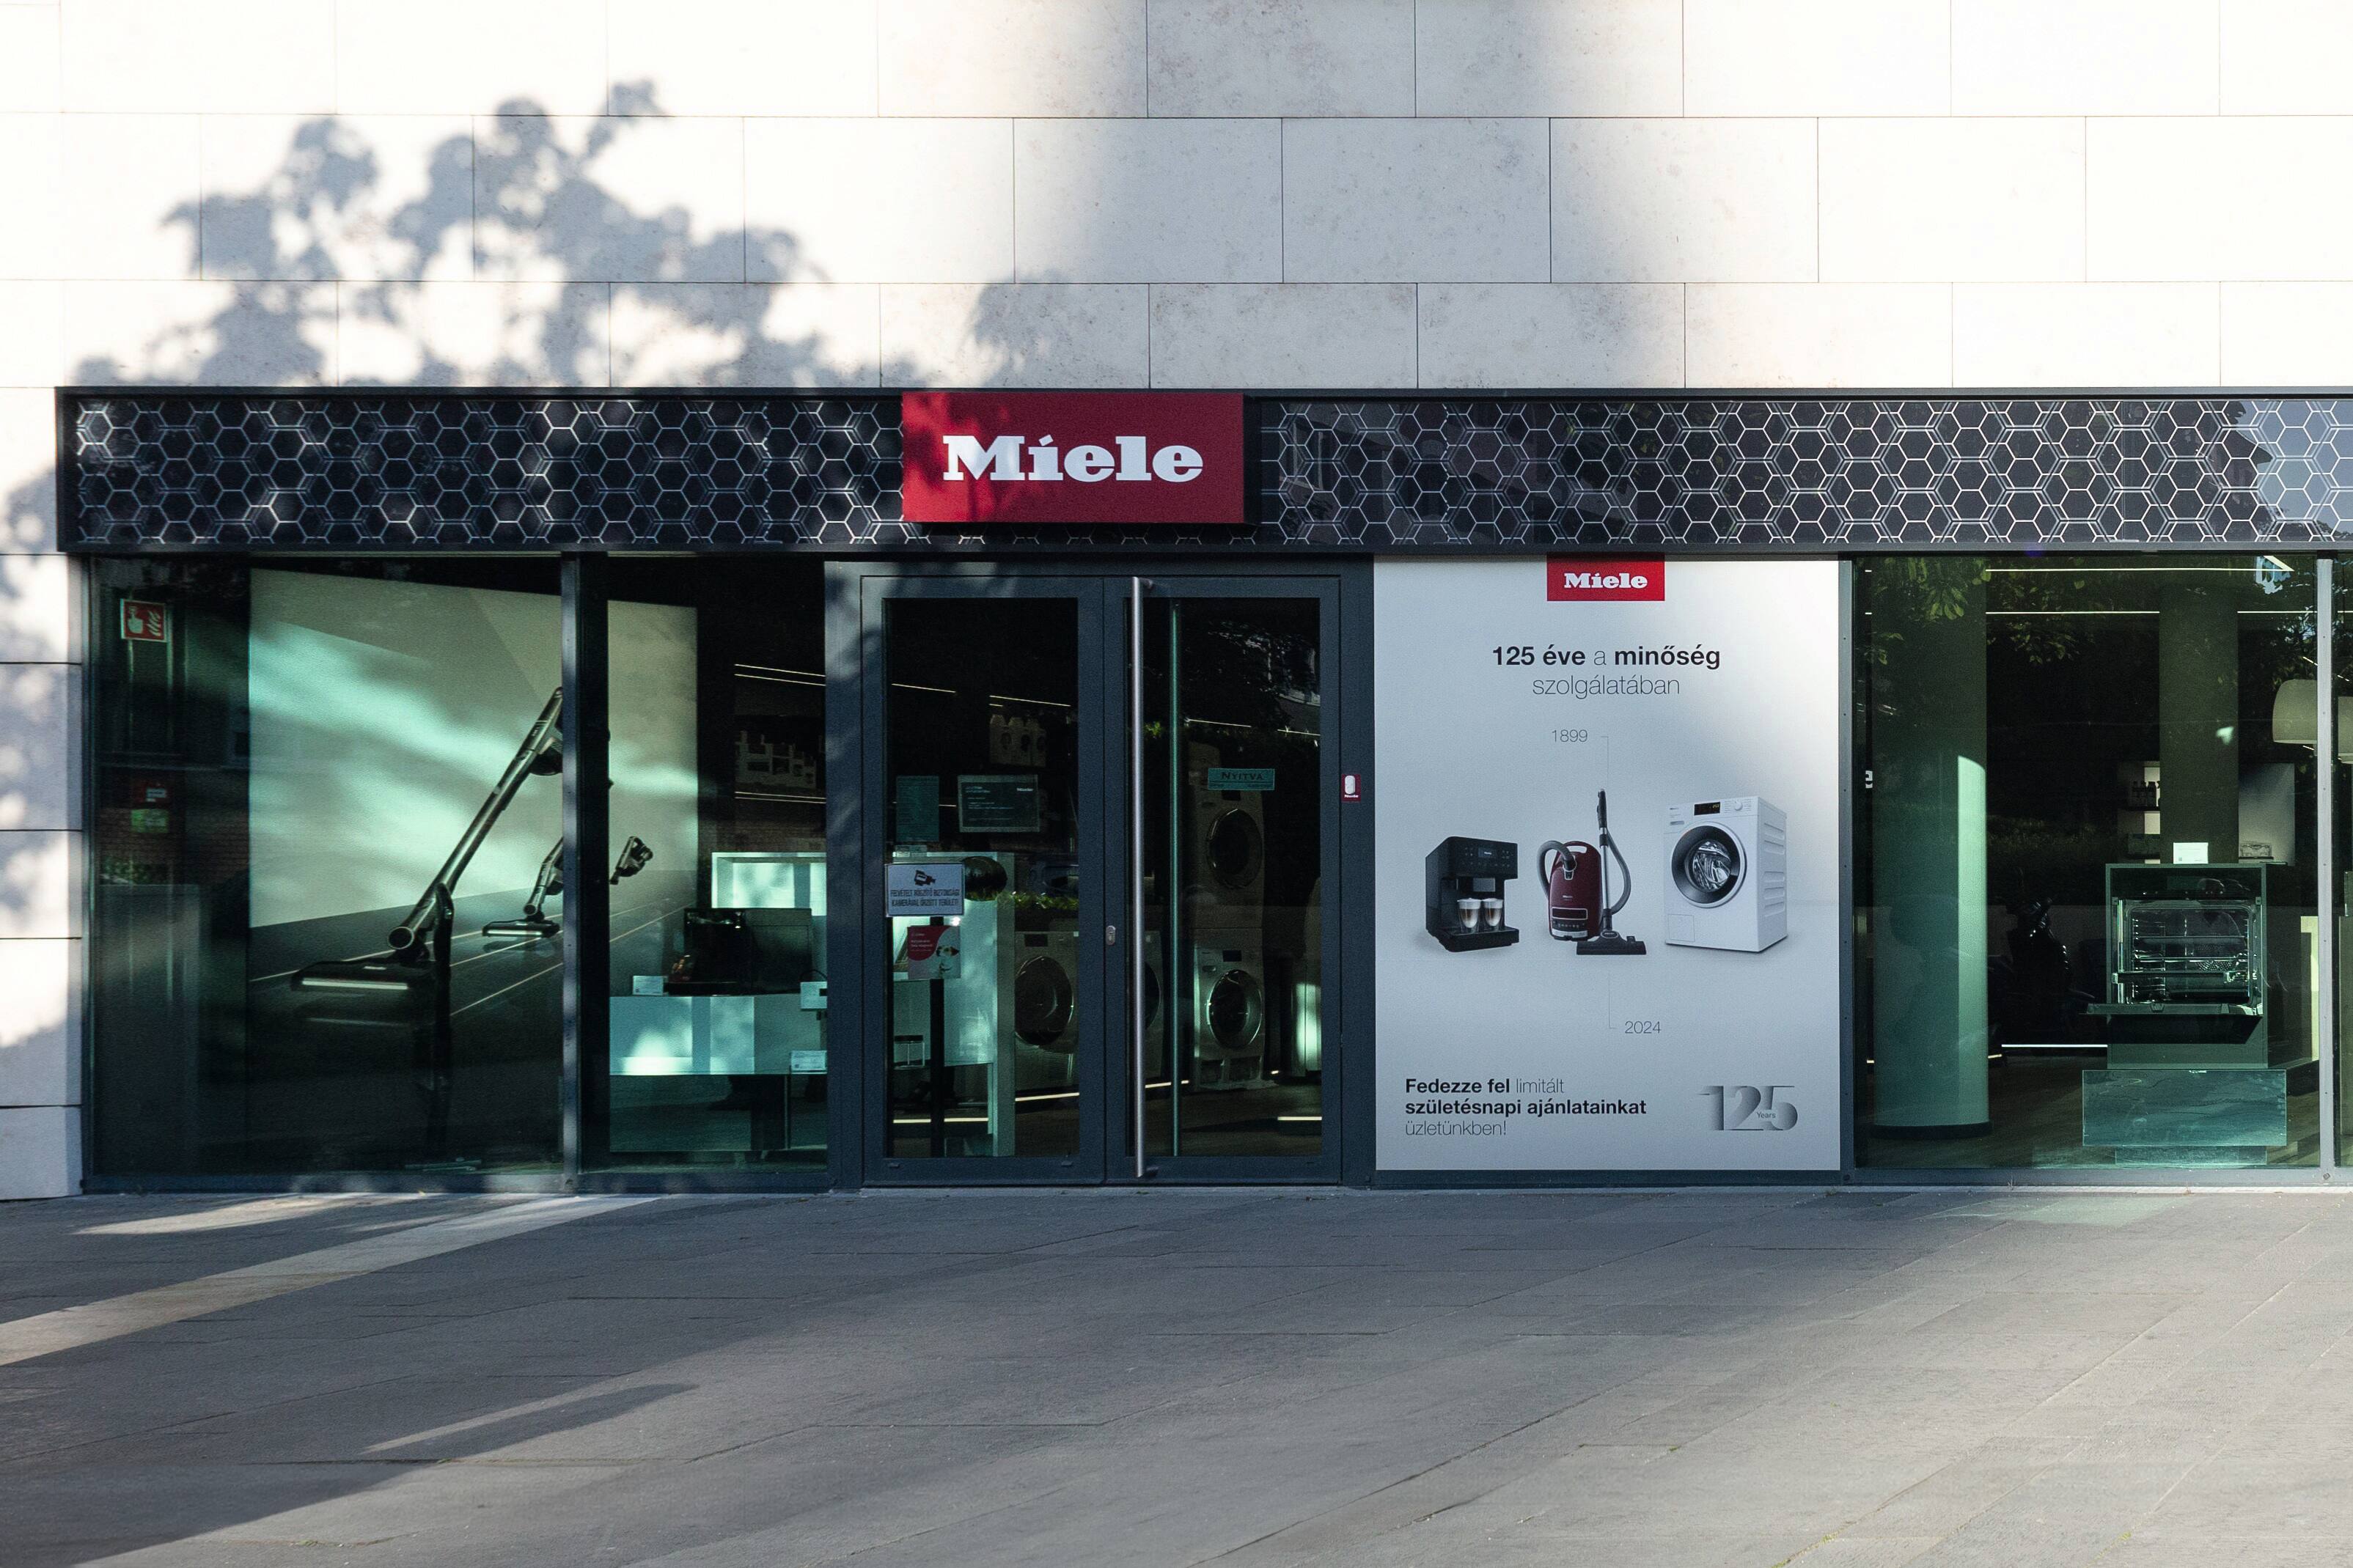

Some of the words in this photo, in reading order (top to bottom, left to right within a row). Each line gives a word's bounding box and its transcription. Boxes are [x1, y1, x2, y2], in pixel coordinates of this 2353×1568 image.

[943, 435, 1203, 482] Miele
[1564, 573, 1648, 589] Miele
[1493, 647, 1535, 666] 125
[1543, 644, 1586, 666] éve
[1593, 650, 1607, 666] a
[1615, 644, 1721, 670] minőség
[1532, 674, 1680, 700] szolgálatában
[1552, 729, 1588, 743] 1899
[1624, 1020, 1662, 1034] 2024
[1406, 1078, 1483, 1094] Fedezze
[1487, 1078, 1510, 1094] fel
[1516, 1078, 1564, 1094] limitált
[1405, 1098, 1521, 1118] születésnapi
[1527, 1098, 1647, 1118] ajánlatainkat
[1697, 1085, 1798, 1131] 125
[1405, 1121, 1506, 1136] üzletünkben!
